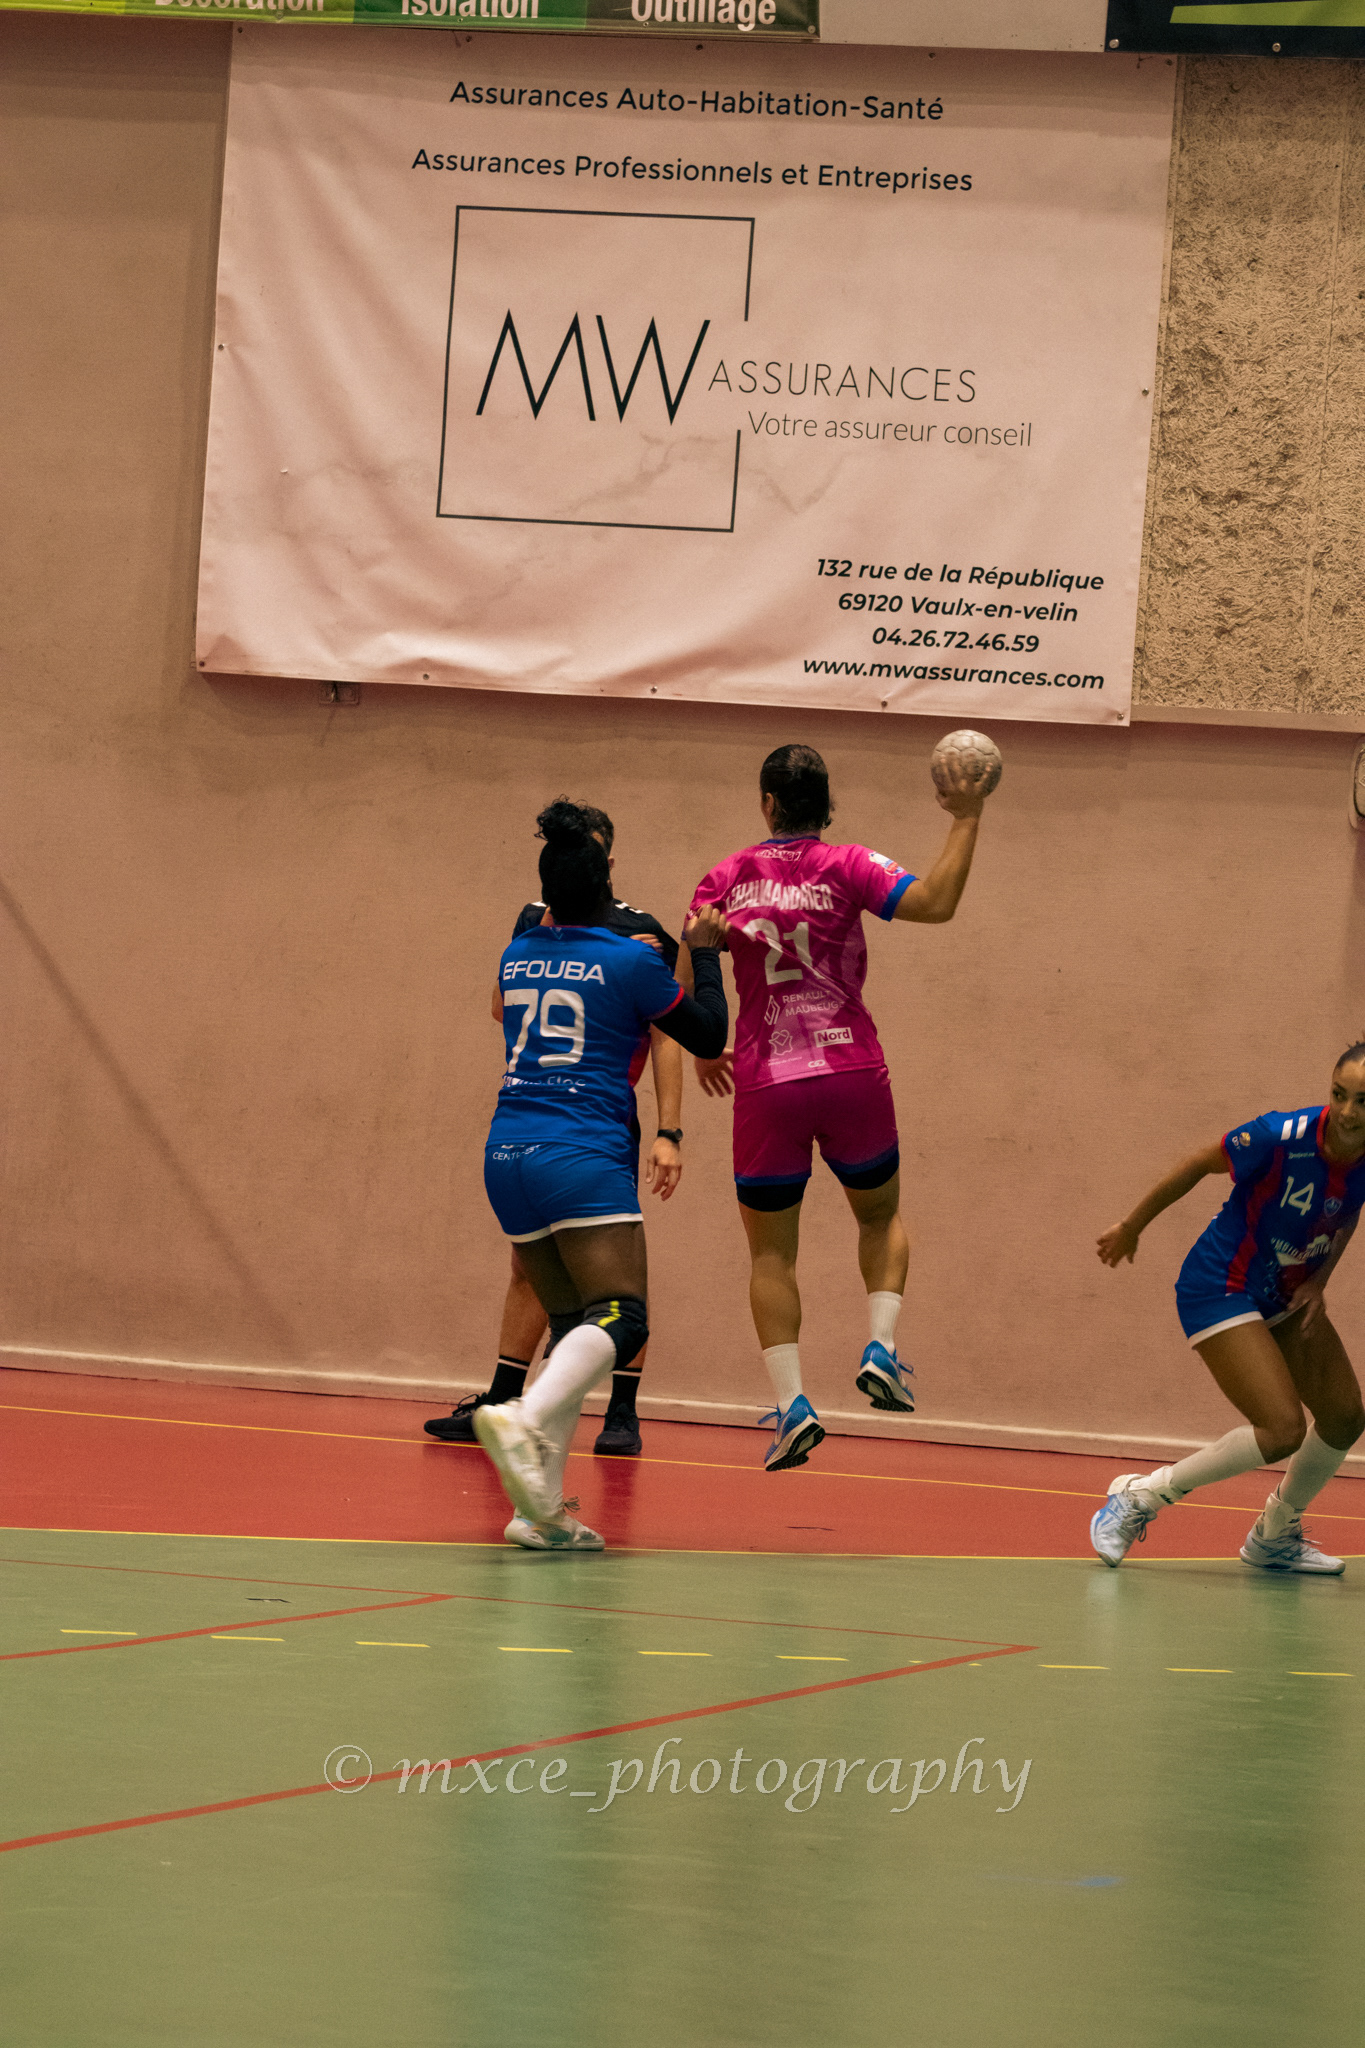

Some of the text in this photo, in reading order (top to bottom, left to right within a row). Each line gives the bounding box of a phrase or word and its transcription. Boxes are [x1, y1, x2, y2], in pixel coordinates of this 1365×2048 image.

[631, 0, 777, 32] Outillage
[450, 82, 944, 121] Assurances Auto-Habitation-Santé
[412, 149, 973, 194] Assurances Professionnels et Entreprises
[475, 308, 711, 426] MW
[708, 359, 977, 403] ASSURANCES
[748, 411, 1032, 447] Votre assureur conseil
[817, 558, 1105, 594] 132 rue de la République
[838, 593, 1078, 623] 69120 Vaulx-en-velin
[872, 627, 1040, 653] 04.26.72.46.59
[803, 659, 1105, 690] www.mwassurances.com
[742, 918, 825, 986] 21
[503, 960, 605, 985] EFOUBA
[782, 990, 831, 1004] RENAULT
[503, 988, 585, 1074] 79
[817, 1029, 850, 1043] Nord
[1280, 1175, 1315, 1216] 14
